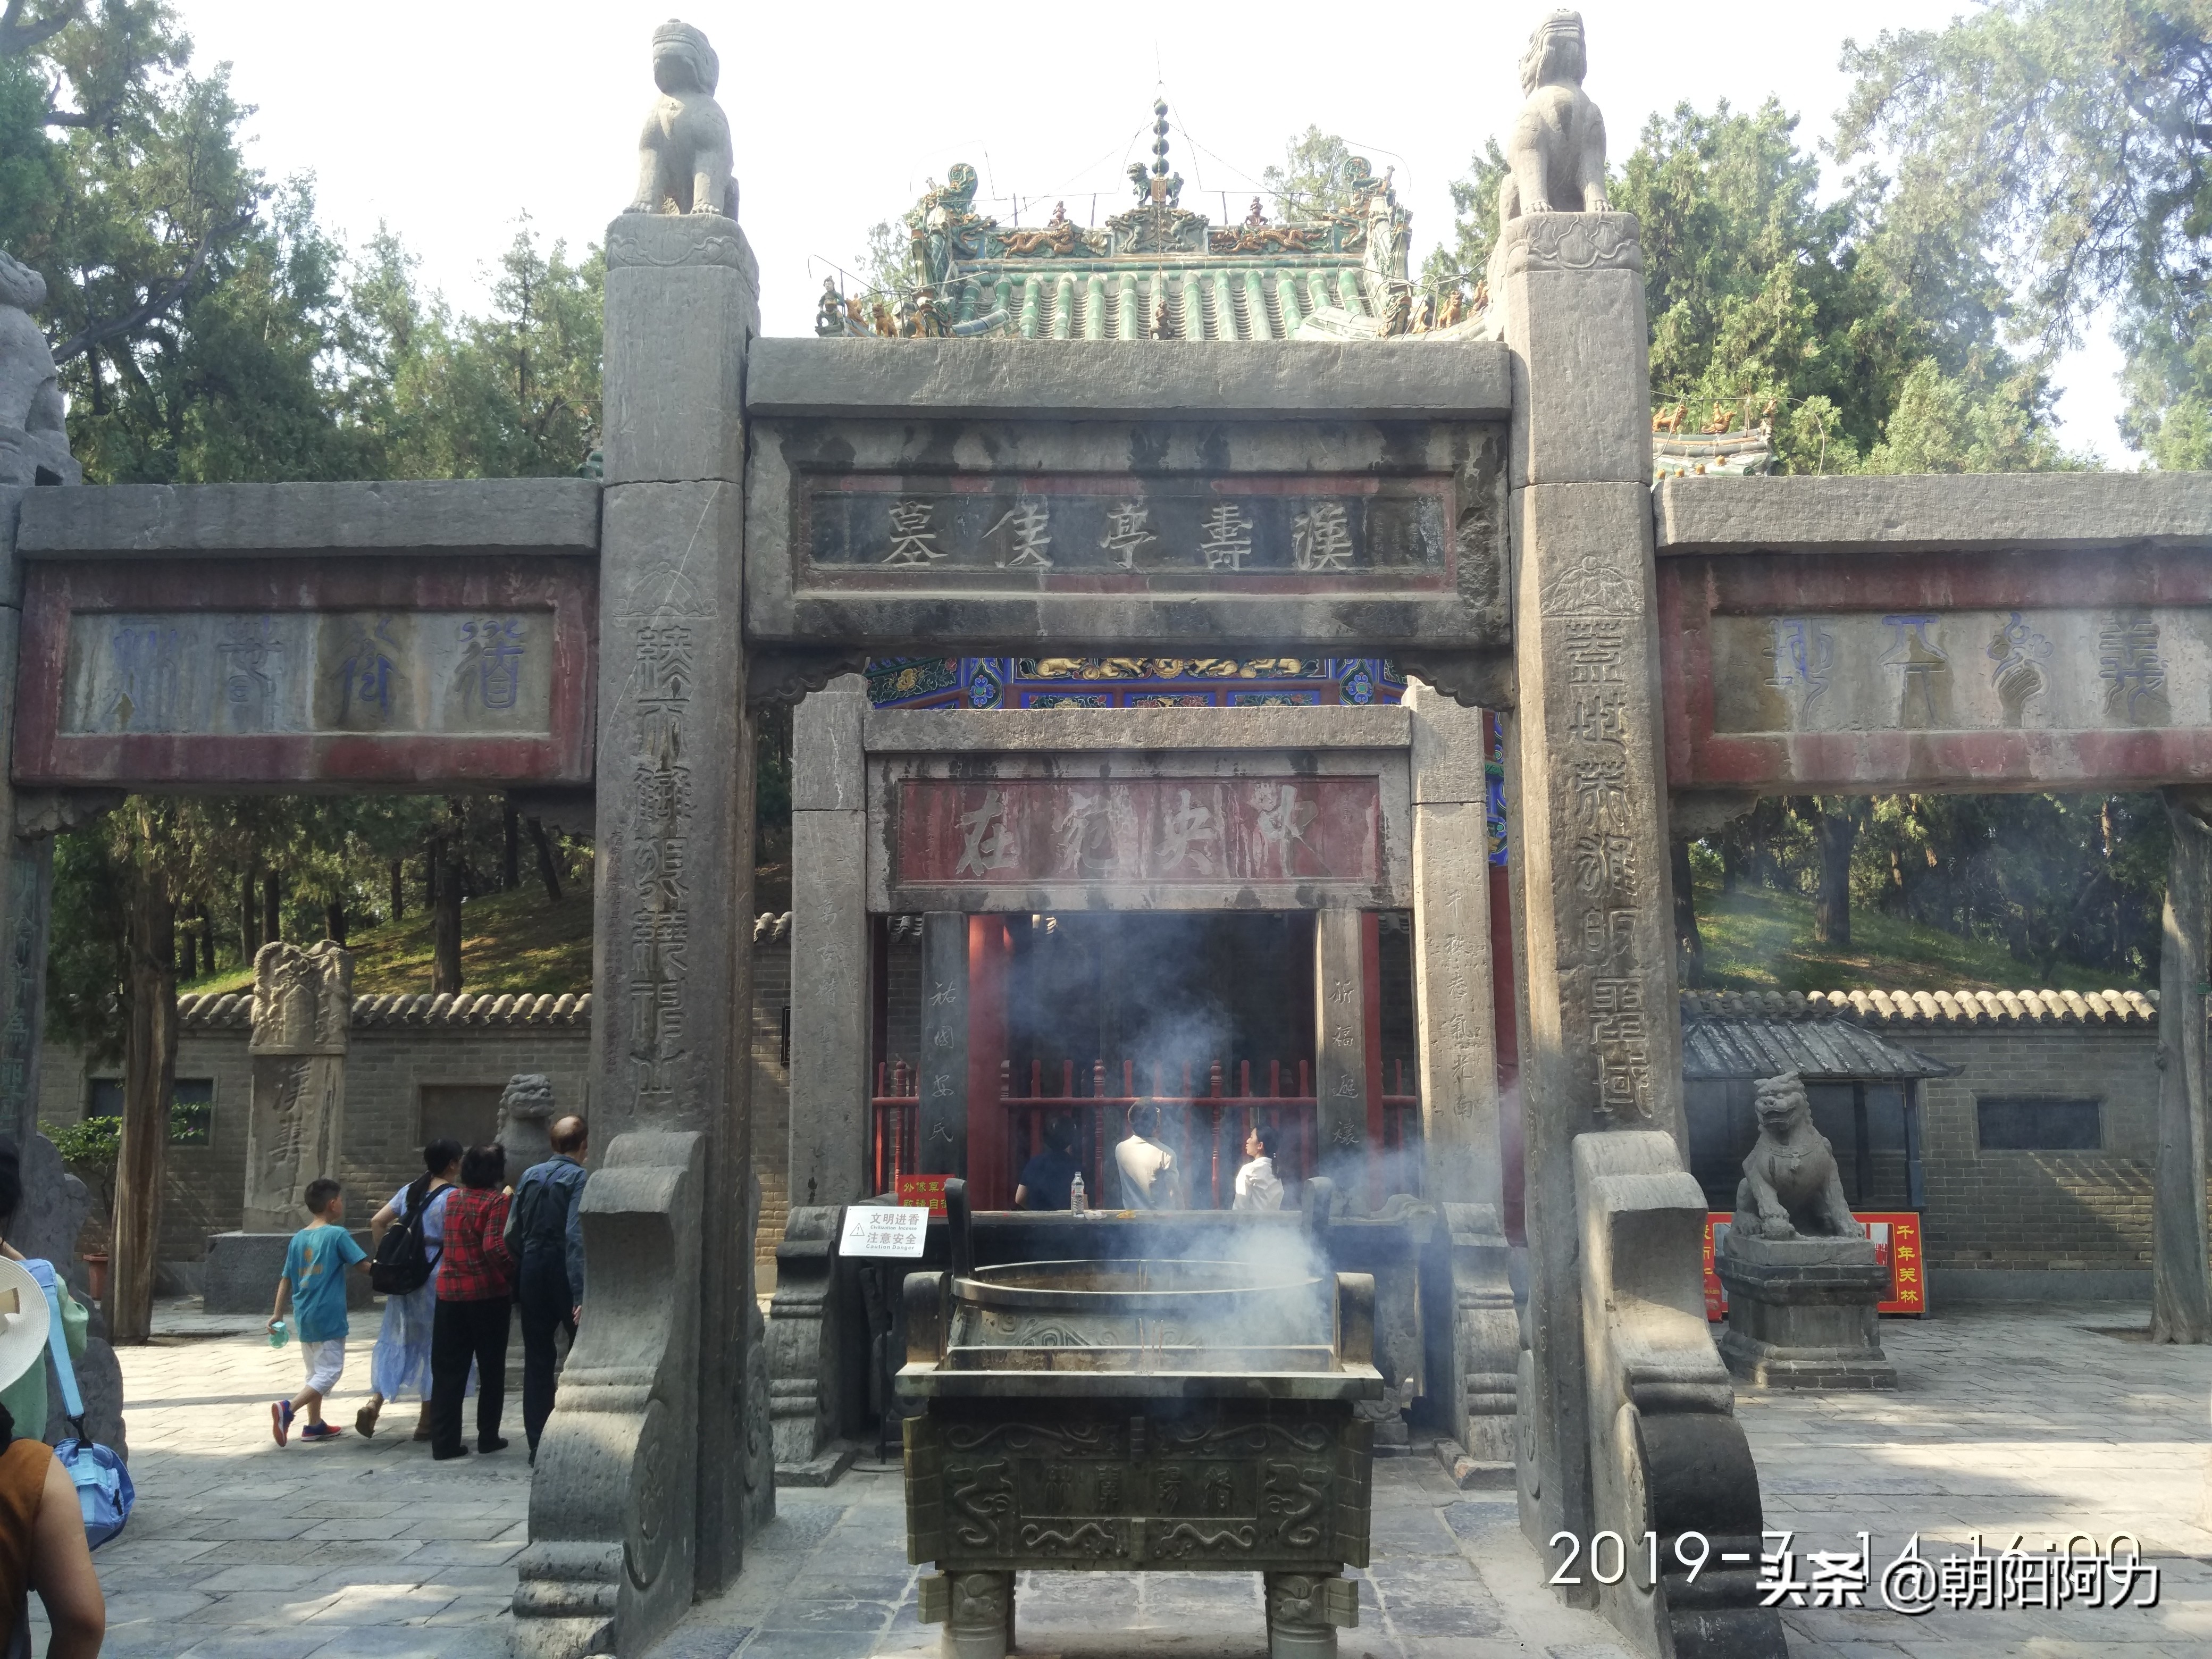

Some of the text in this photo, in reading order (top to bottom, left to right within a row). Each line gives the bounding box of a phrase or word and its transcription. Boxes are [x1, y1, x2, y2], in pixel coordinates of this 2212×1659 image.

[869, 1212, 920, 1226] 文明进香
[867, 1232, 917, 1245] 注意安全
[1897, 1225, 1919, 1304] 千年关林
